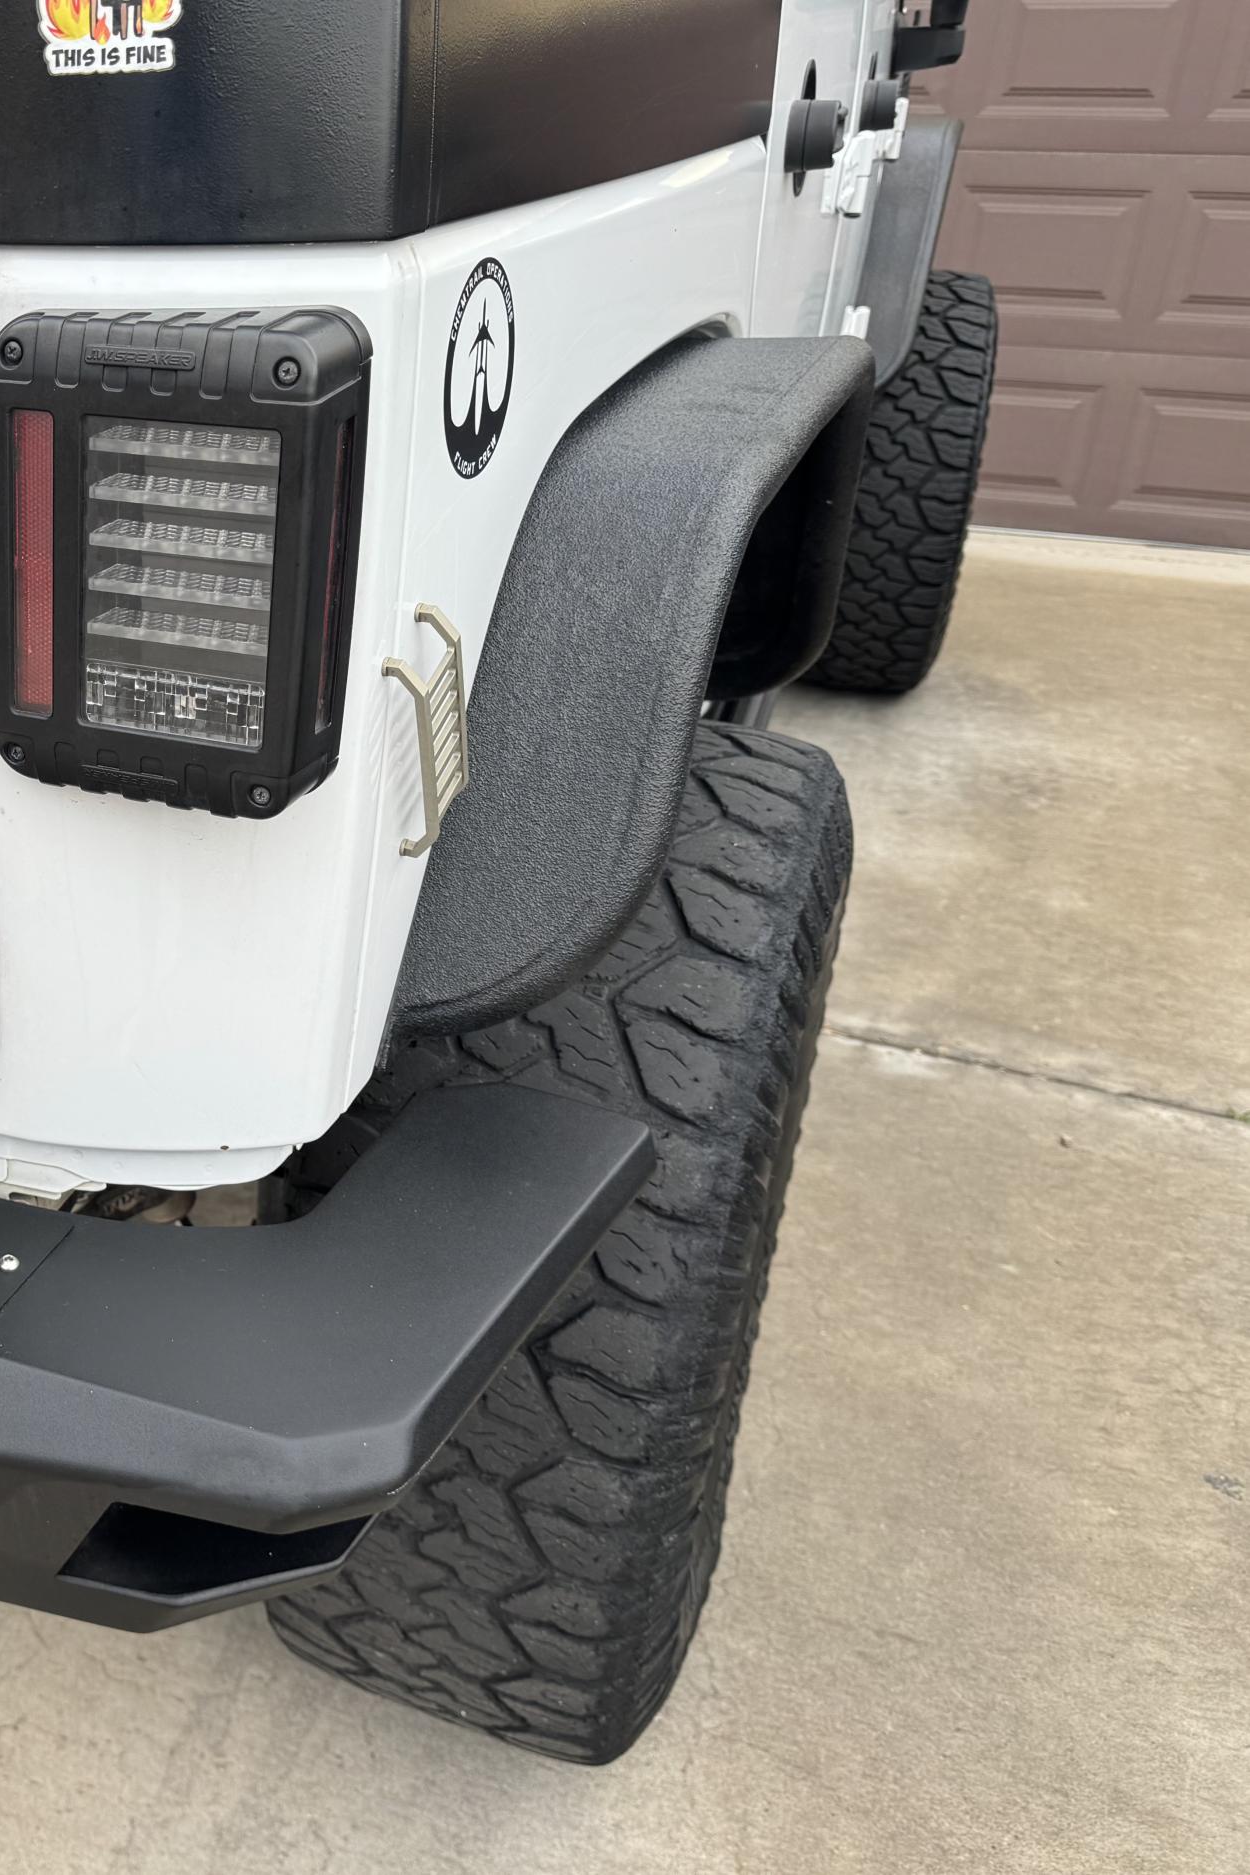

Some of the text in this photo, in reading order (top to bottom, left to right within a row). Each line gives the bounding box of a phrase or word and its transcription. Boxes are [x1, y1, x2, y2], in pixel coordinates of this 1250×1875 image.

[52, 45, 166, 67] THIS IS FINE
[451, 262, 514, 341] CHEMTRAIL OPERATIONS
[454, 433, 496, 476] FLIGHT CREW
